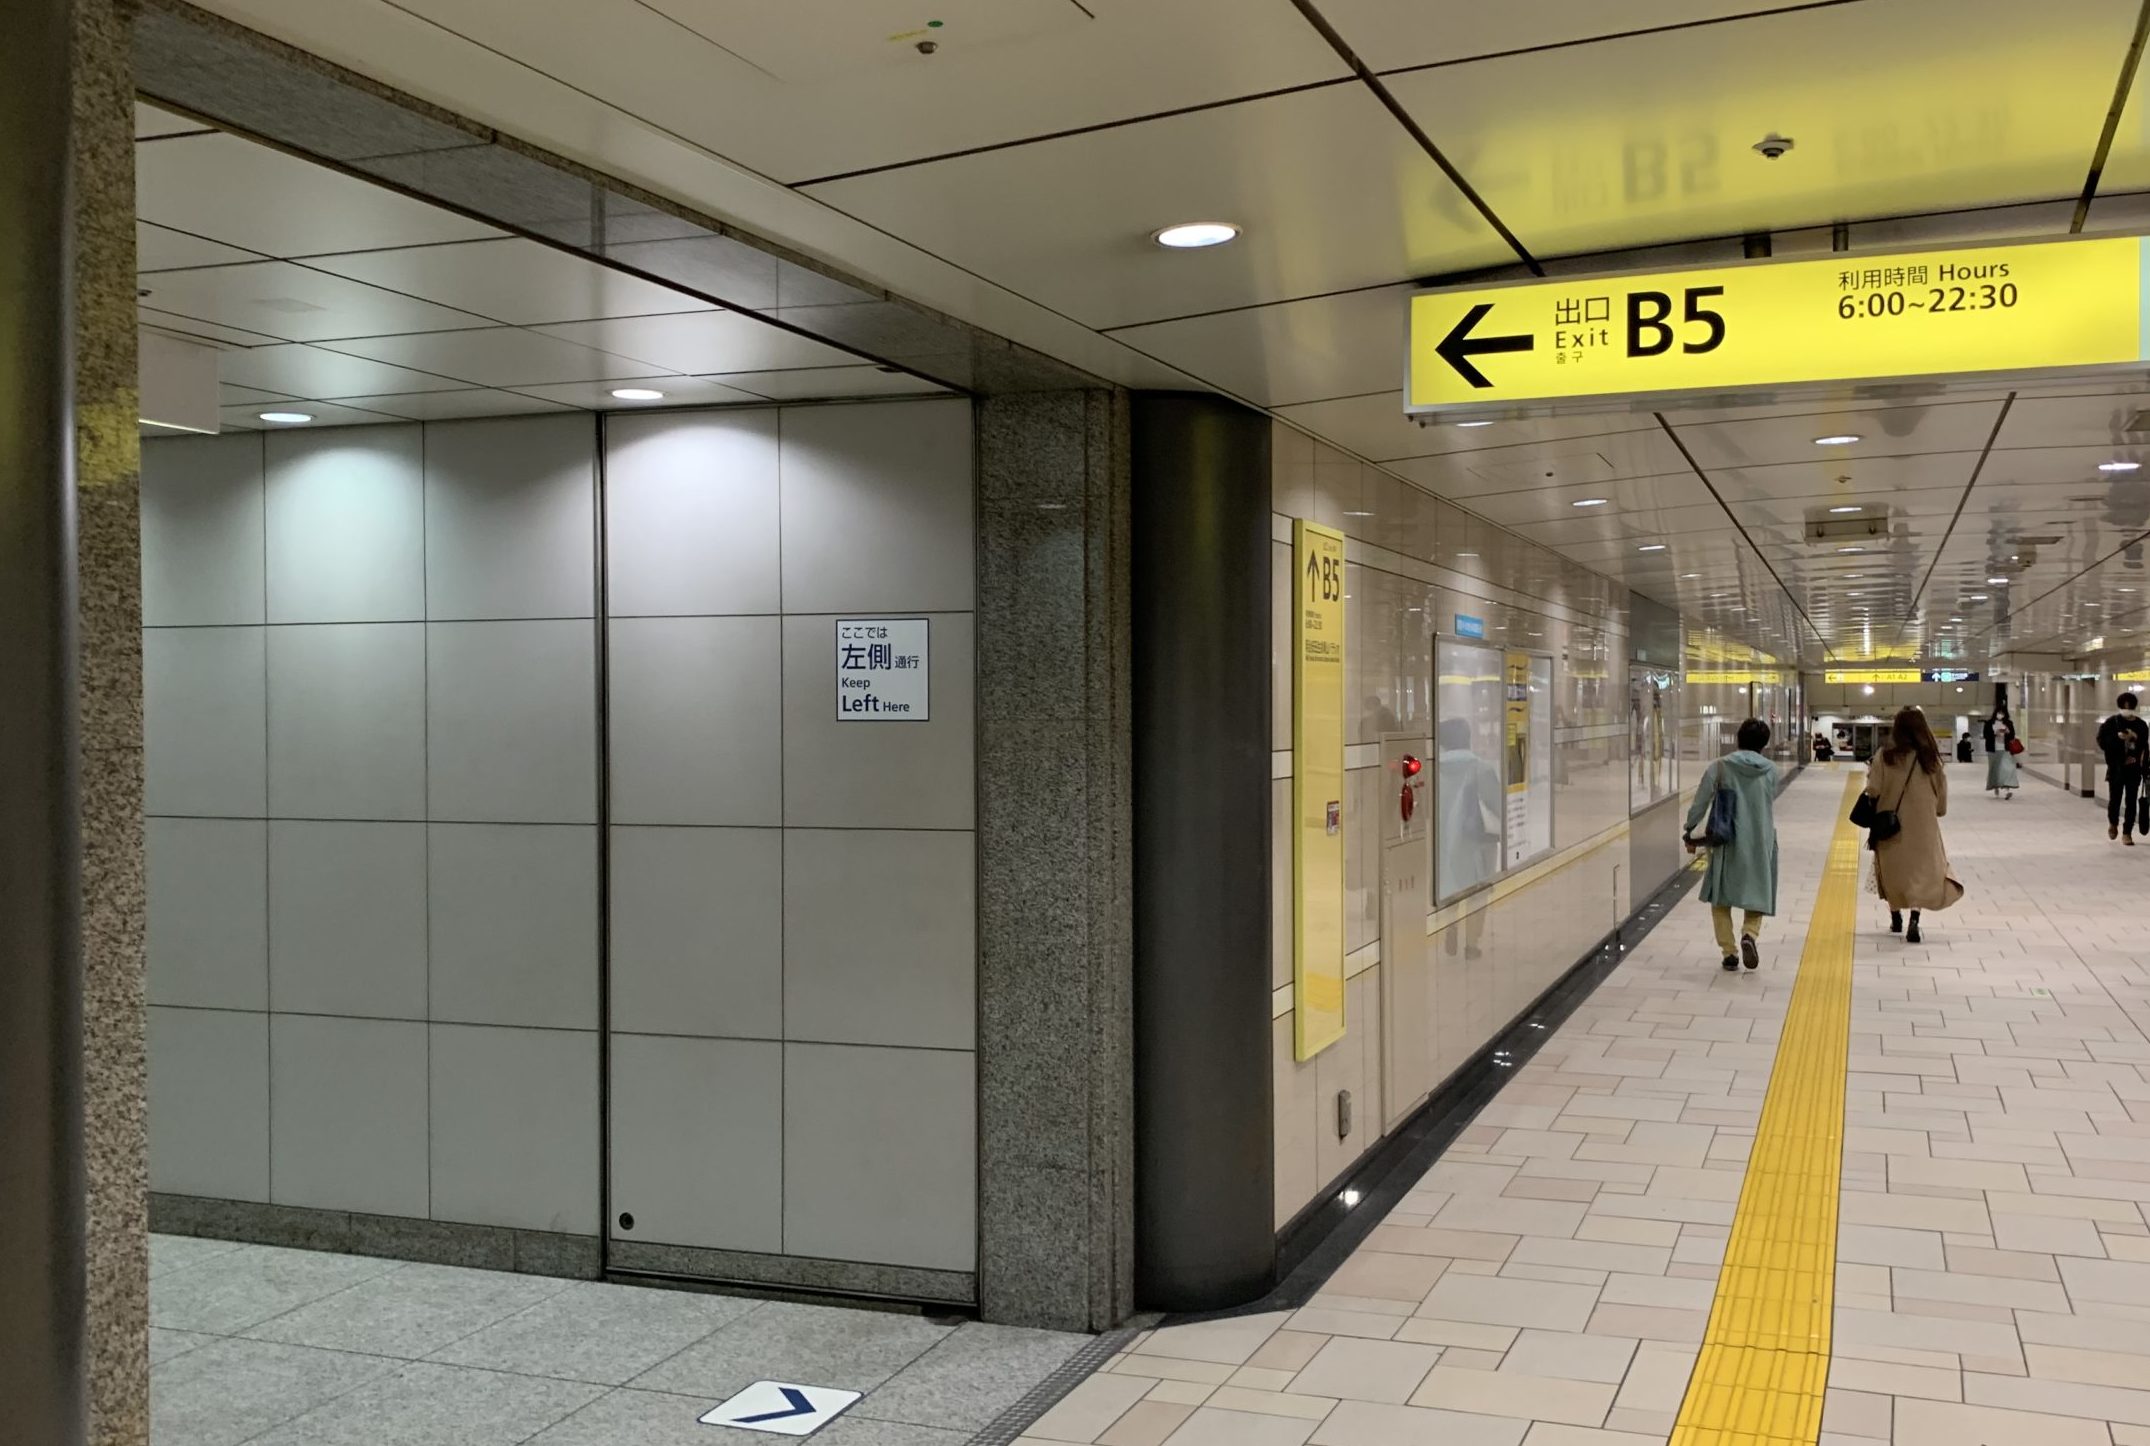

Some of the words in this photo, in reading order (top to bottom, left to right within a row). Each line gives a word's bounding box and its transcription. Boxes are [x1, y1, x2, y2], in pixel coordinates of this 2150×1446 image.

[1838, 265, 1928, 291] 利用時間
[1939, 263, 2010, 282] Hours
[1556, 296, 1609, 326] 出口
[1626, 285, 1726, 358] B5
[1556, 328, 1609, 349] Exit
[1323, 556, 1340, 602] B5
[842, 626, 888, 639] ここでは
[841, 643, 892, 670] 左側
[894, 655, 920, 669] 通行
[841, 677, 871, 690] Keep
[842, 694, 880, 712] Left
[883, 701, 910, 712] Here
